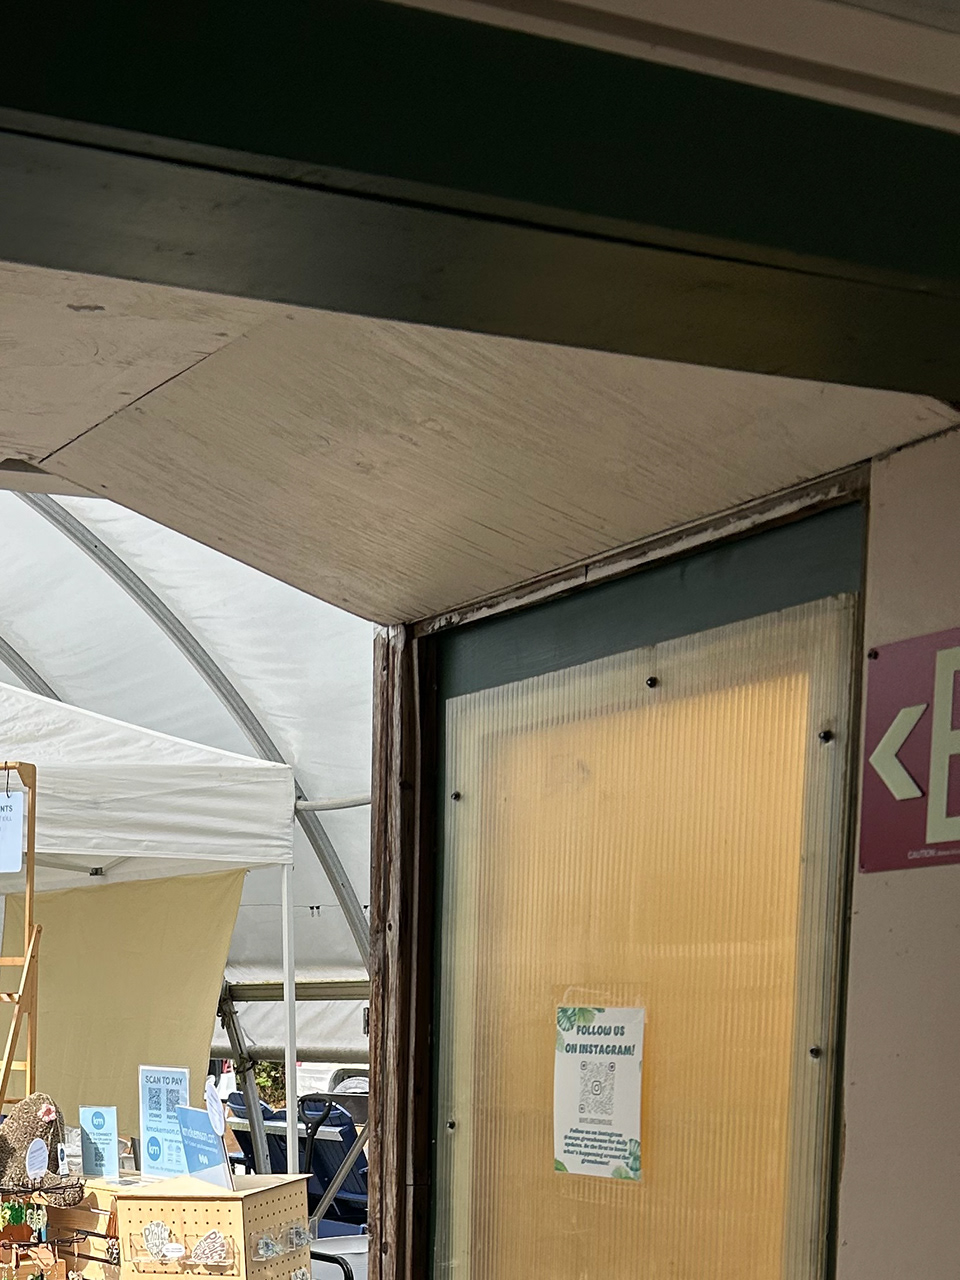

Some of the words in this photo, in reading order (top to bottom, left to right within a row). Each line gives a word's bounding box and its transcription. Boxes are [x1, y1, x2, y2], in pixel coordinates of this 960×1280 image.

[576, 1025, 612, 1036] FOLLOW
[613, 1025, 625, 1036] US
[565, 1043, 577, 1054] ON
[578, 1043, 636, 1056] INSTAGRAM!
[145, 1075, 161, 1084] SCAN
[161, 1077, 171, 1085] TO
[171, 1077, 183, 1086] PAY
[93, 1116, 103, 1125] km
[149, 1143, 160, 1155] km
